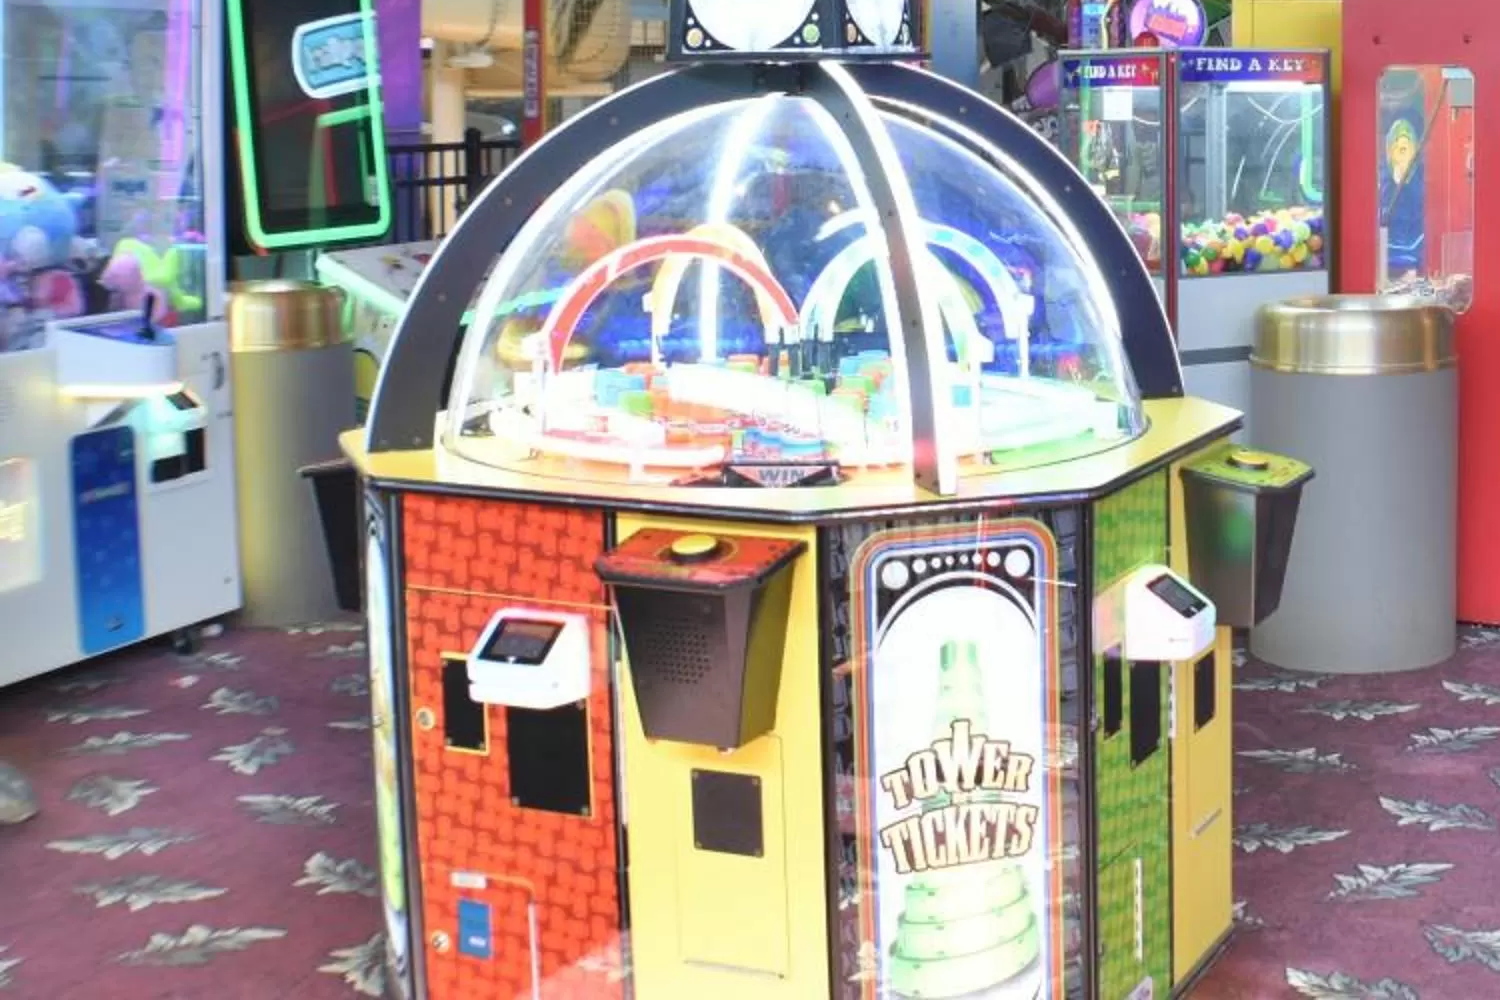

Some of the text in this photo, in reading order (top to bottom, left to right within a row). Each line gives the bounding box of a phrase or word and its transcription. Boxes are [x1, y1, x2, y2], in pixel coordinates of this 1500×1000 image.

[1195, 58, 1304, 72] FIND A KEY
[758, 468, 806, 483] WIN
[880, 718, 1035, 810] TOWER
[879, 801, 1040, 875] TICKETS
